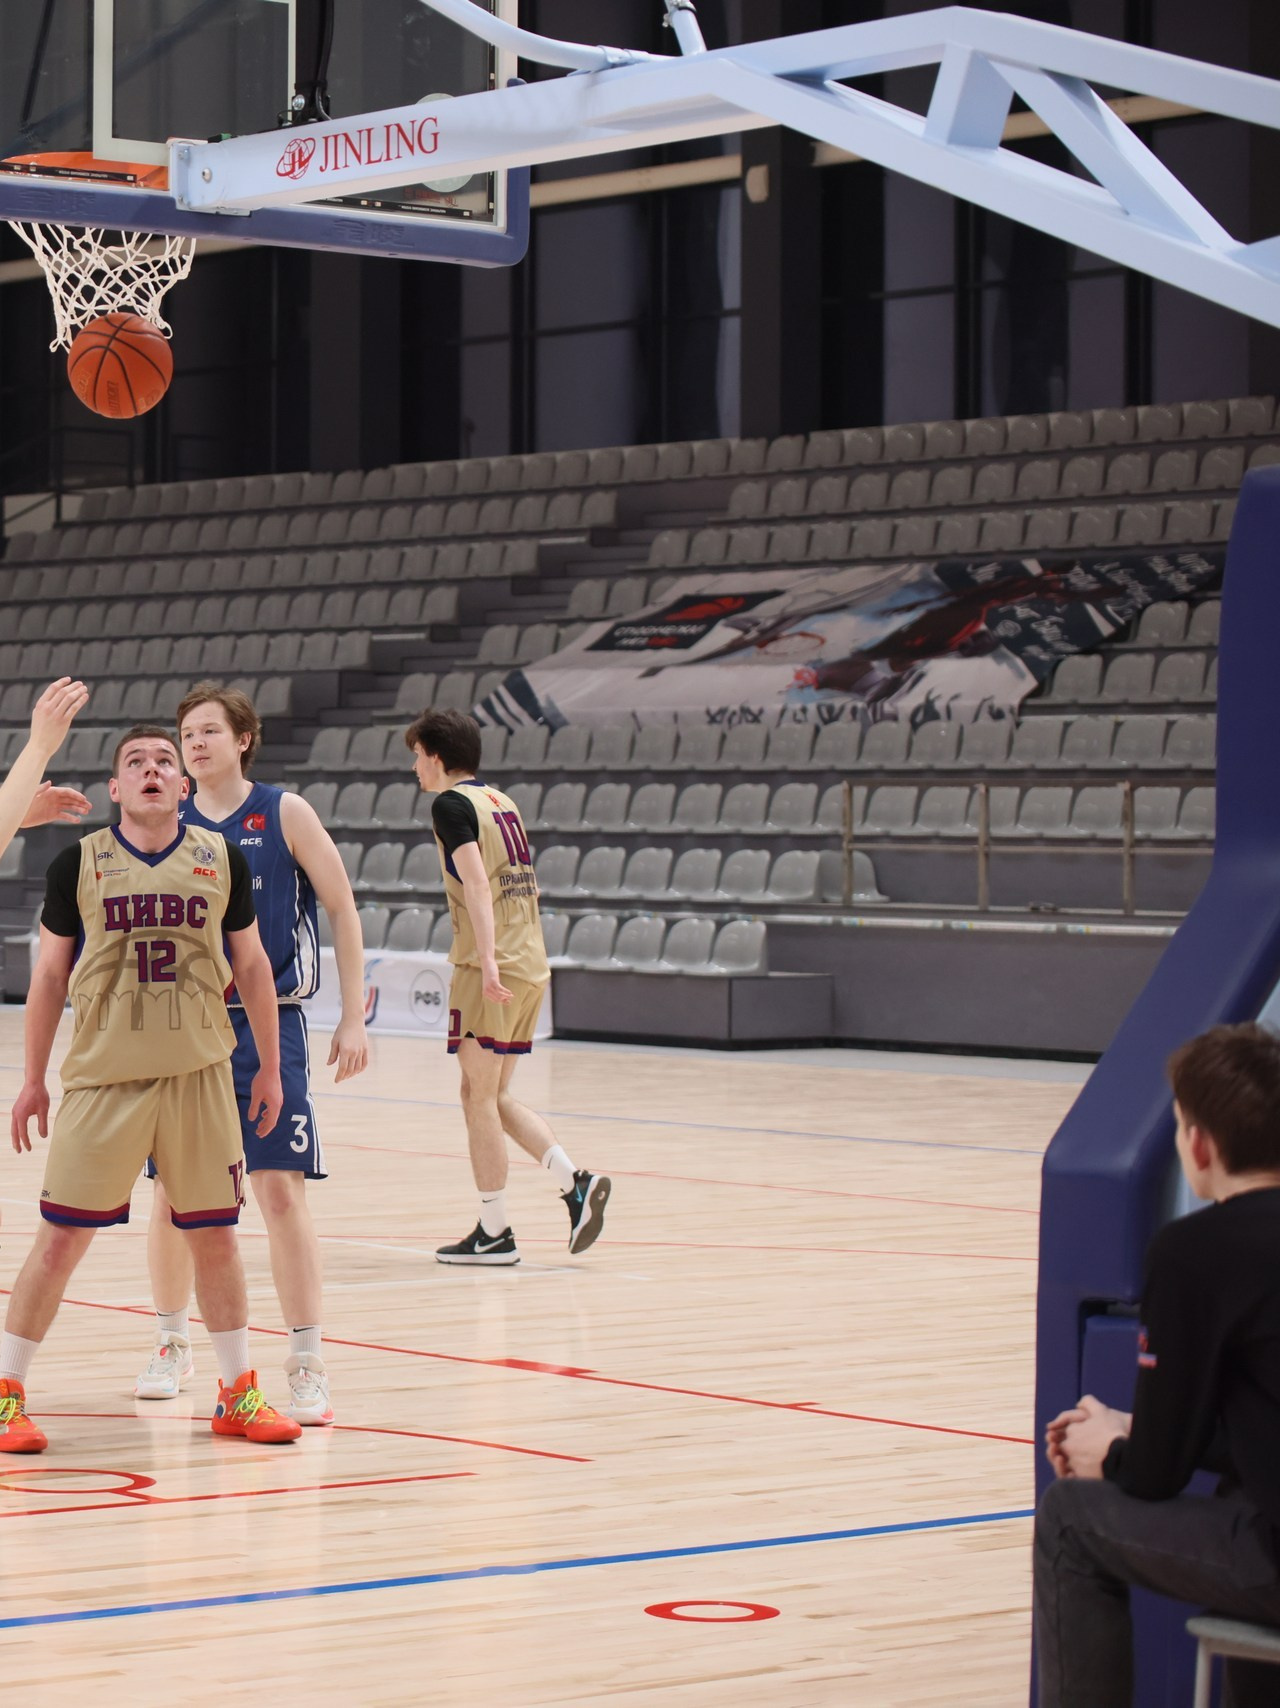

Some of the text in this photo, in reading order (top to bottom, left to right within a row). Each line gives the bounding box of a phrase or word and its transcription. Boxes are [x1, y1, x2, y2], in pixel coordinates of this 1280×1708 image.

[319, 117, 440, 172] JINLING
[492, 809, 532, 867] 10
[103, 893, 209, 933] ЦИВС
[134, 940, 177, 983] 12
[414, 990, 441, 1006] РФБ
[289, 1114, 309, 1154] 3
